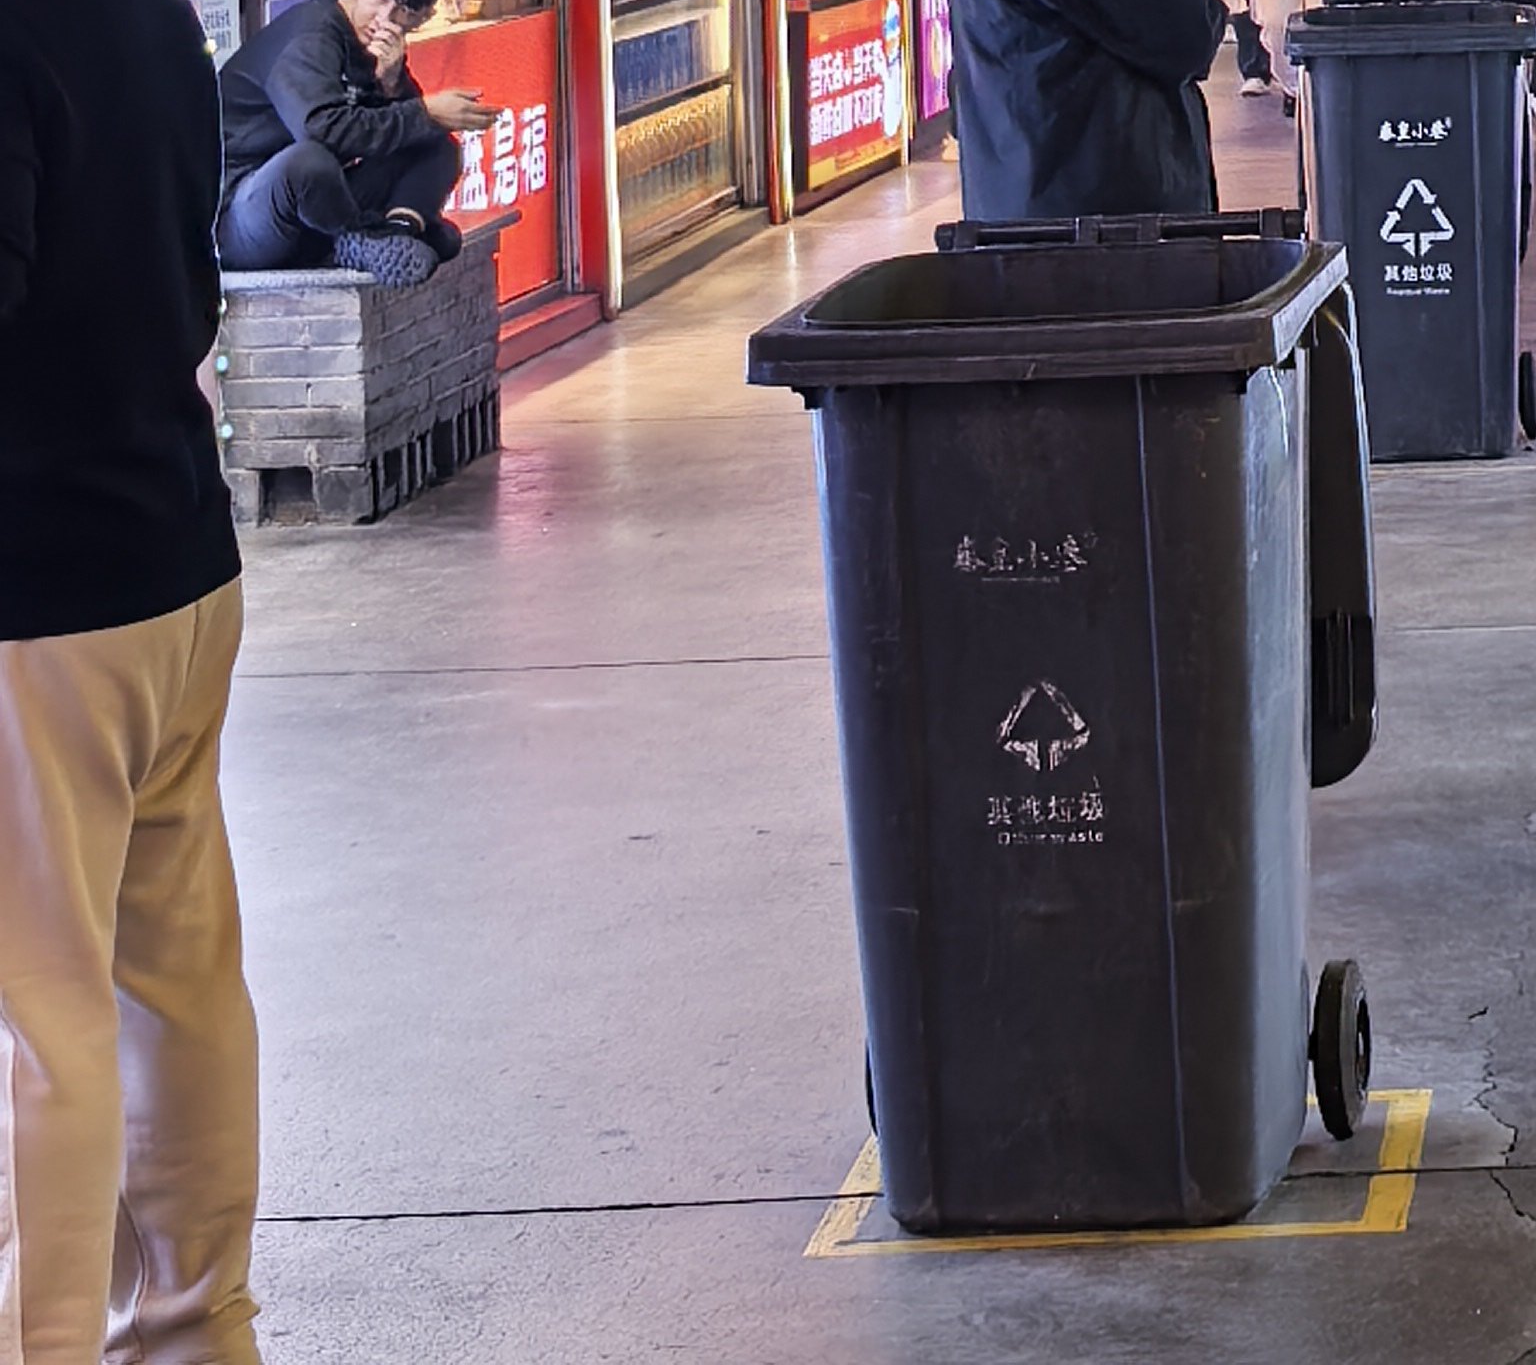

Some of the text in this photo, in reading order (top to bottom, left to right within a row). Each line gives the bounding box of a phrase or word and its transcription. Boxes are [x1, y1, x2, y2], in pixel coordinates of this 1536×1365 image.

[1378, 120, 1448, 142] 秦皇小巷
[1384, 262, 1453, 281] 其他垃圾
